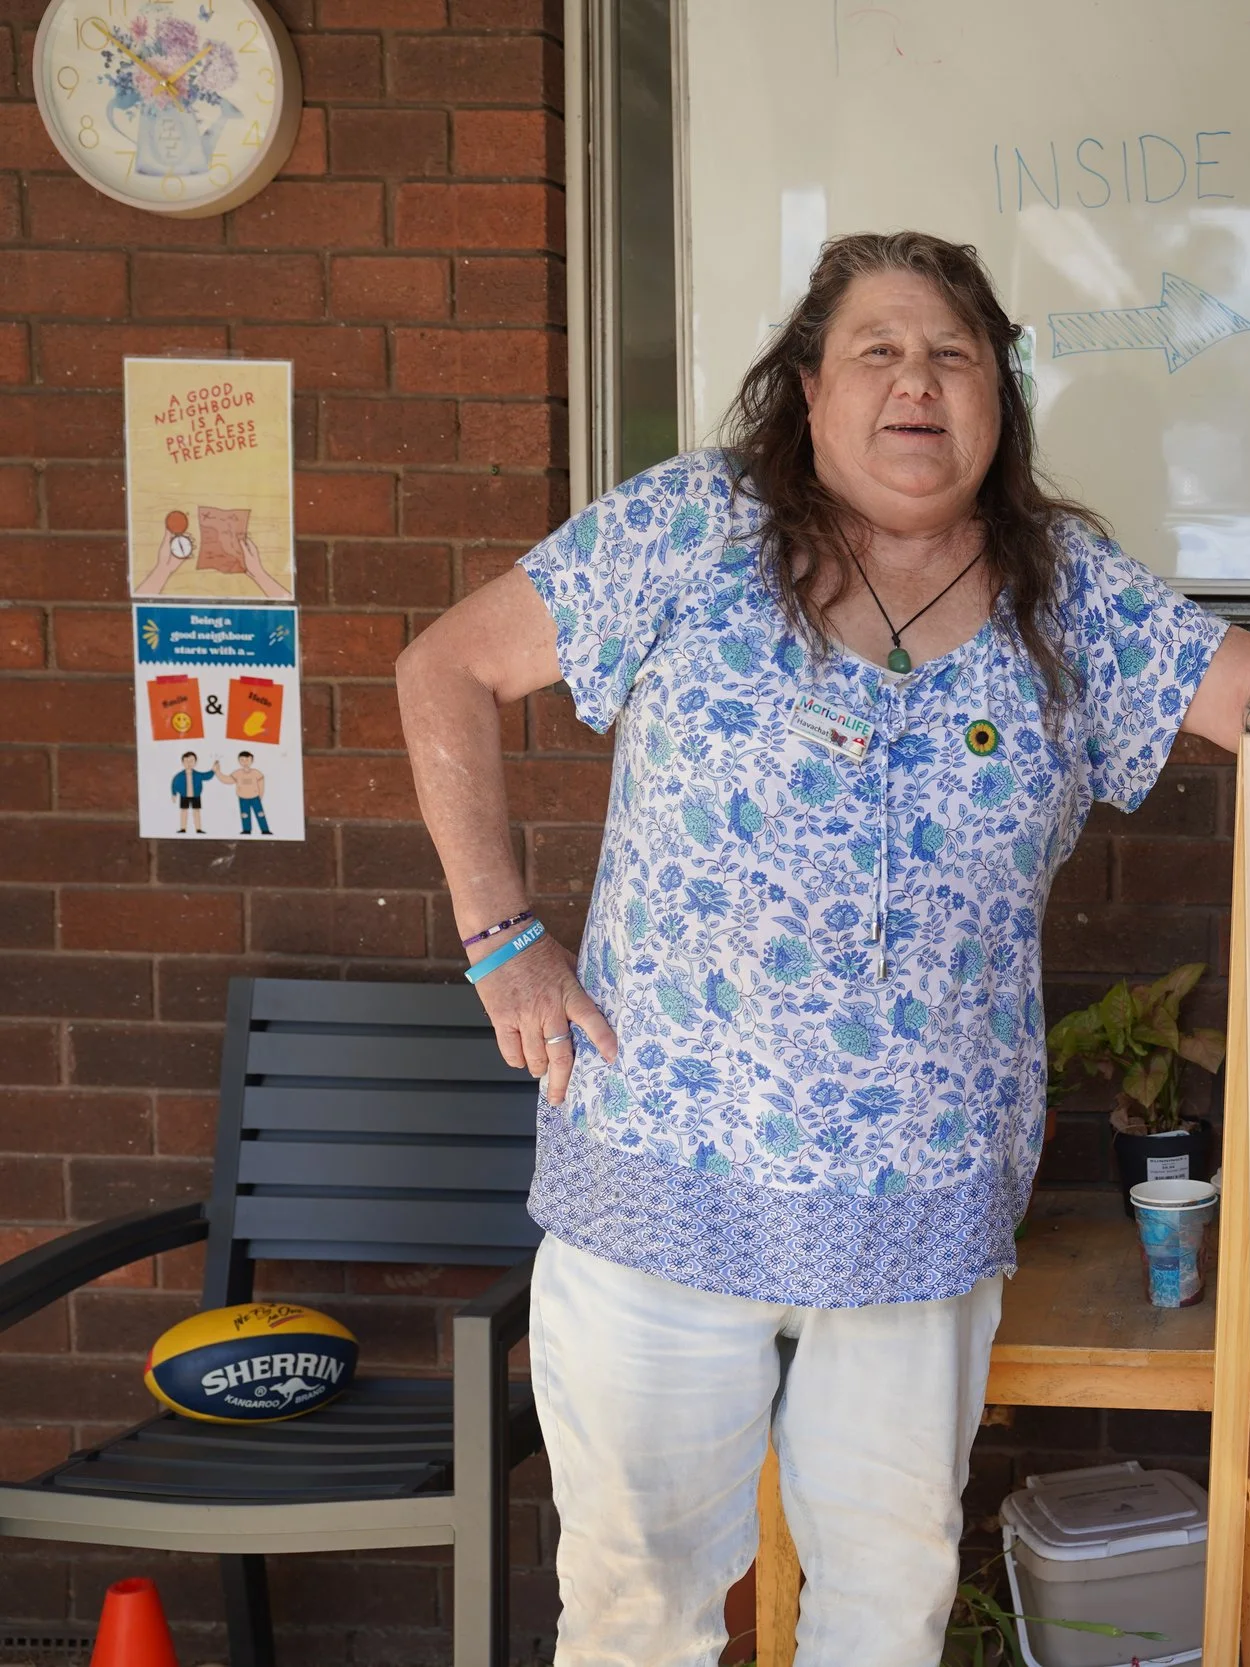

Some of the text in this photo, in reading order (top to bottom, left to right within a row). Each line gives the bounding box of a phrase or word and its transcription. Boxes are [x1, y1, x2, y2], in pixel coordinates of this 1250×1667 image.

[73, 16, 111, 51] 10
[237, 19, 259, 53] 2
[57, 65, 80, 100] 9
[256, 66, 276, 105] 3
[78, 114, 99, 149] 8
[241, 119, 262, 148] 4
[114, 151, 136, 184] 7
[160, 165, 185, 198] 6
[208, 154, 233, 188] 5
[994, 131, 1234, 213] INSIDE
[154, 391, 255, 426] NEIGHBOUR
[169, 382, 233, 408] A GOOD
[166, 420, 255, 450] PRICELESS
[191, 413, 225, 431] IS A
[170, 434, 258, 464] TREASURE
[170, 630, 255, 643] good neighbour
[190, 615, 232, 629] Being a
[174, 646, 208, 655] starts
[209, 645, 236, 656] with
[237, 648, 245, 656] a
[205, 694, 224, 716] &
[201, 1352, 345, 1396] SHERRIN
[224, 1384, 326, 1409] KANGAROO BRAND
